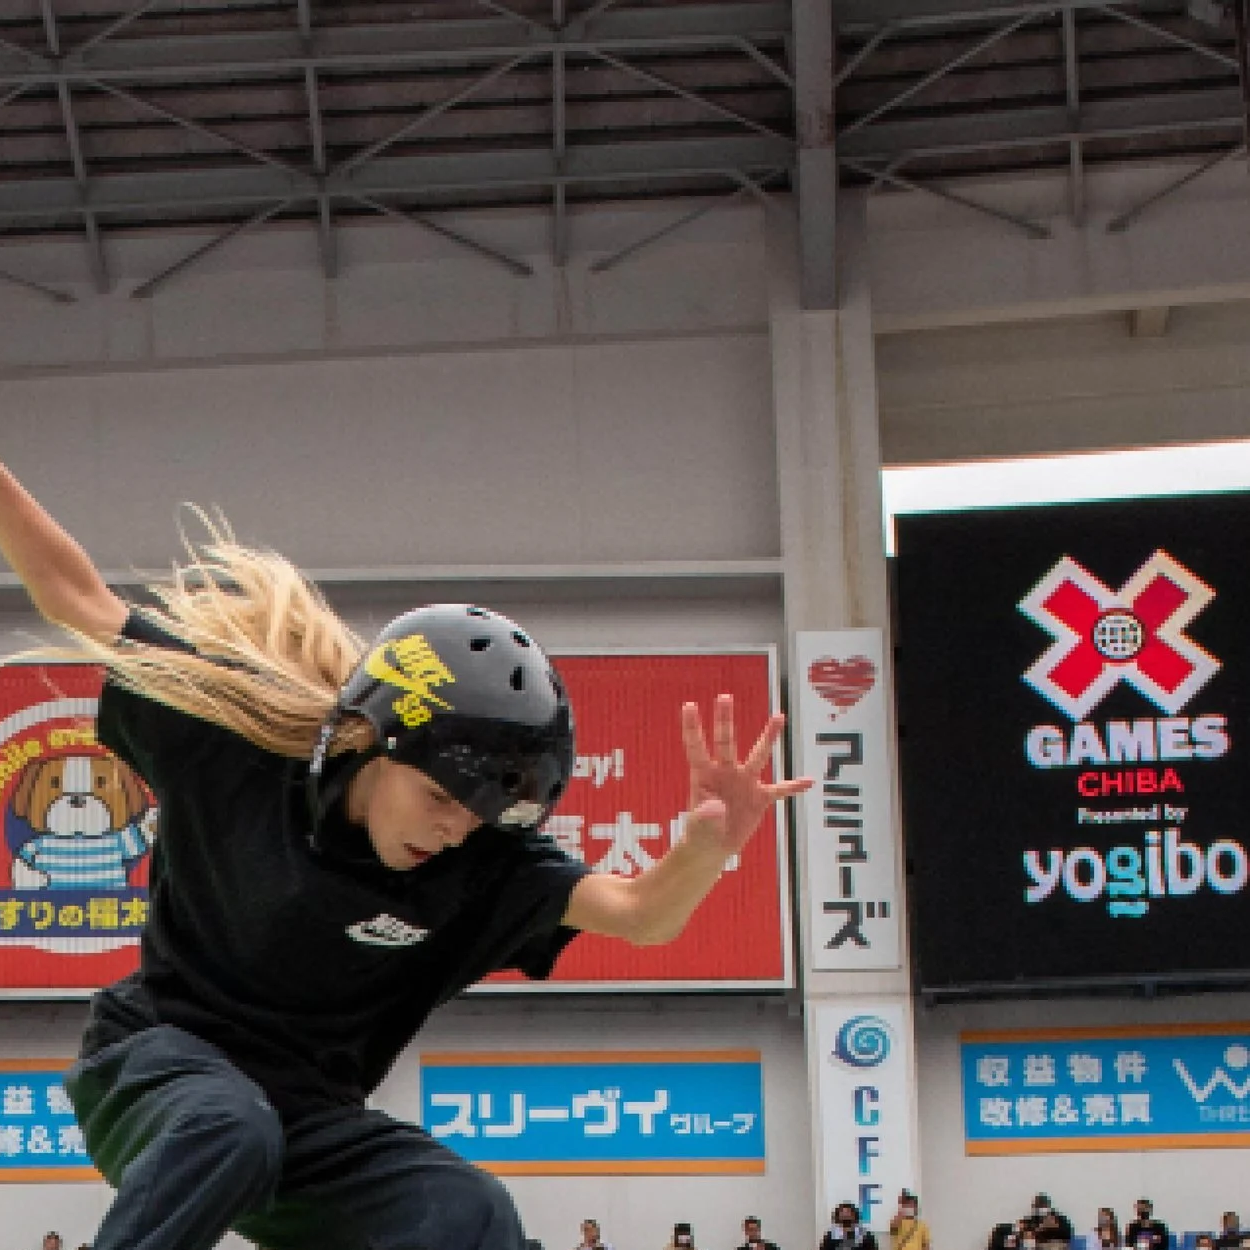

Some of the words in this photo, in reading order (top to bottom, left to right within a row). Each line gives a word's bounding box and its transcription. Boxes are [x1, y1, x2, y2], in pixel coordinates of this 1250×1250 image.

[1025, 714, 1231, 769] GAMES
[1077, 768, 1185, 797] CHIBA
[816, 732, 890, 950] アミューズ
[1022, 827, 1248, 918] yogibo
